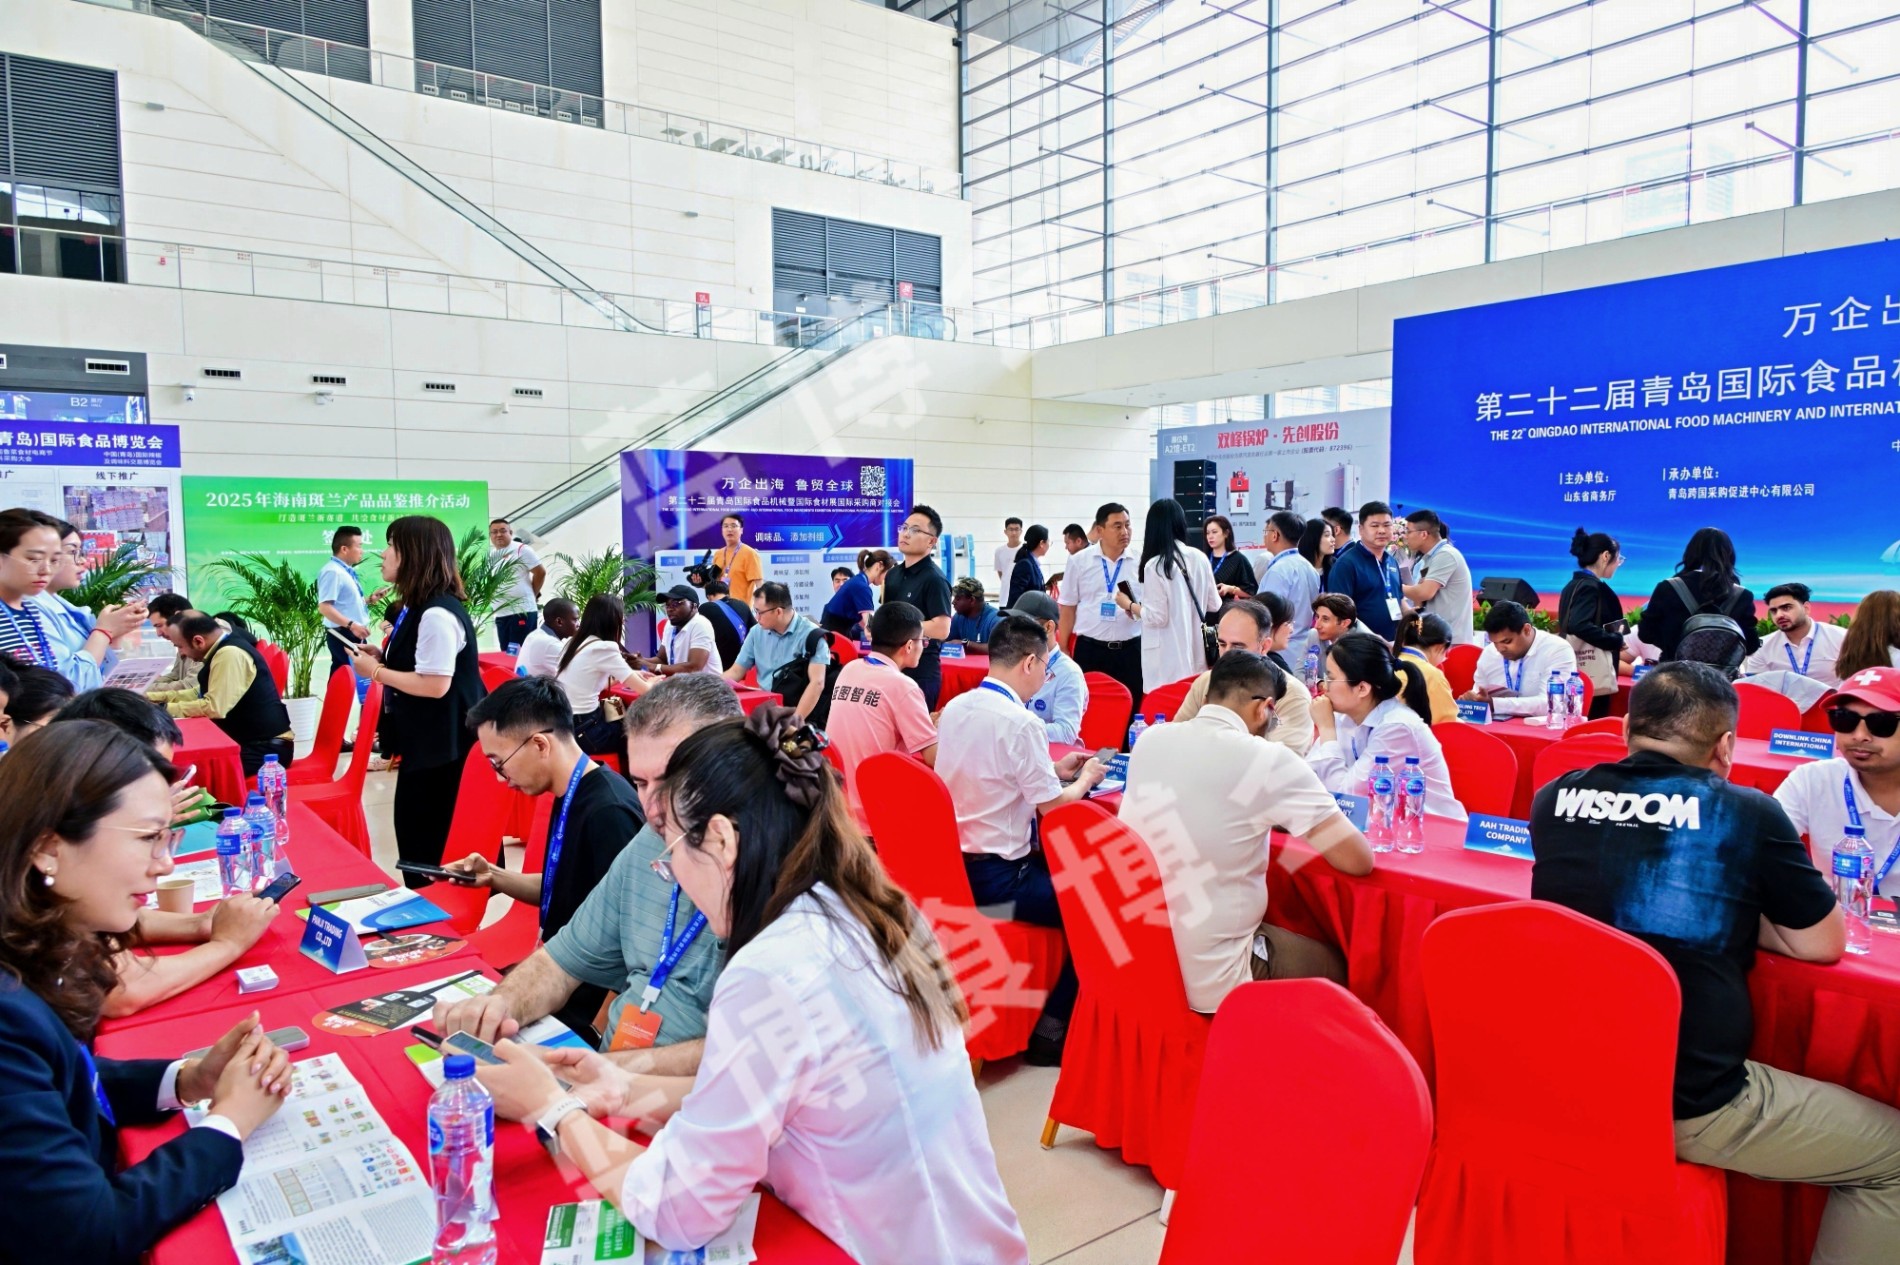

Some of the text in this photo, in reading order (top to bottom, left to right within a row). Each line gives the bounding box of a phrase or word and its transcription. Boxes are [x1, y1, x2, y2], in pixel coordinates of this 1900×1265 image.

[1475, 355, 1900, 422] 第二十二届青岛国际食品
[71, 397, 88, 407] B2
[1490, 430, 1510, 441] THE
[1528, 424, 1578, 438] QINGDAO
[1580, 417, 1672, 435] INTERNATIONAL
[1675, 415, 1710, 428] FOOD
[1713, 408, 1792, 426] MACHINERY
[1795, 406, 1827, 420] AND
[96, 471, 139, 480] 线下推广
[721, 477, 854, 492] 万企出海 鲁贸全球
[1668, 483, 1815, 500] 青岛跨国采购促进中心有限公司
[1564, 490, 1617, 502] 山东省商务厅
[322, 529, 373, 545] 签处
[1773, 732, 1832, 744] DOWNLINK CHINA
[1774, 740, 1828, 751] INTERNATIONAL
[1554, 787, 1701, 830] WISDOM
[1479, 820, 1530, 835] AAH TRADIN
[1486, 831, 1527, 844] COMPANY
[324, 920, 343, 939] TRADING
